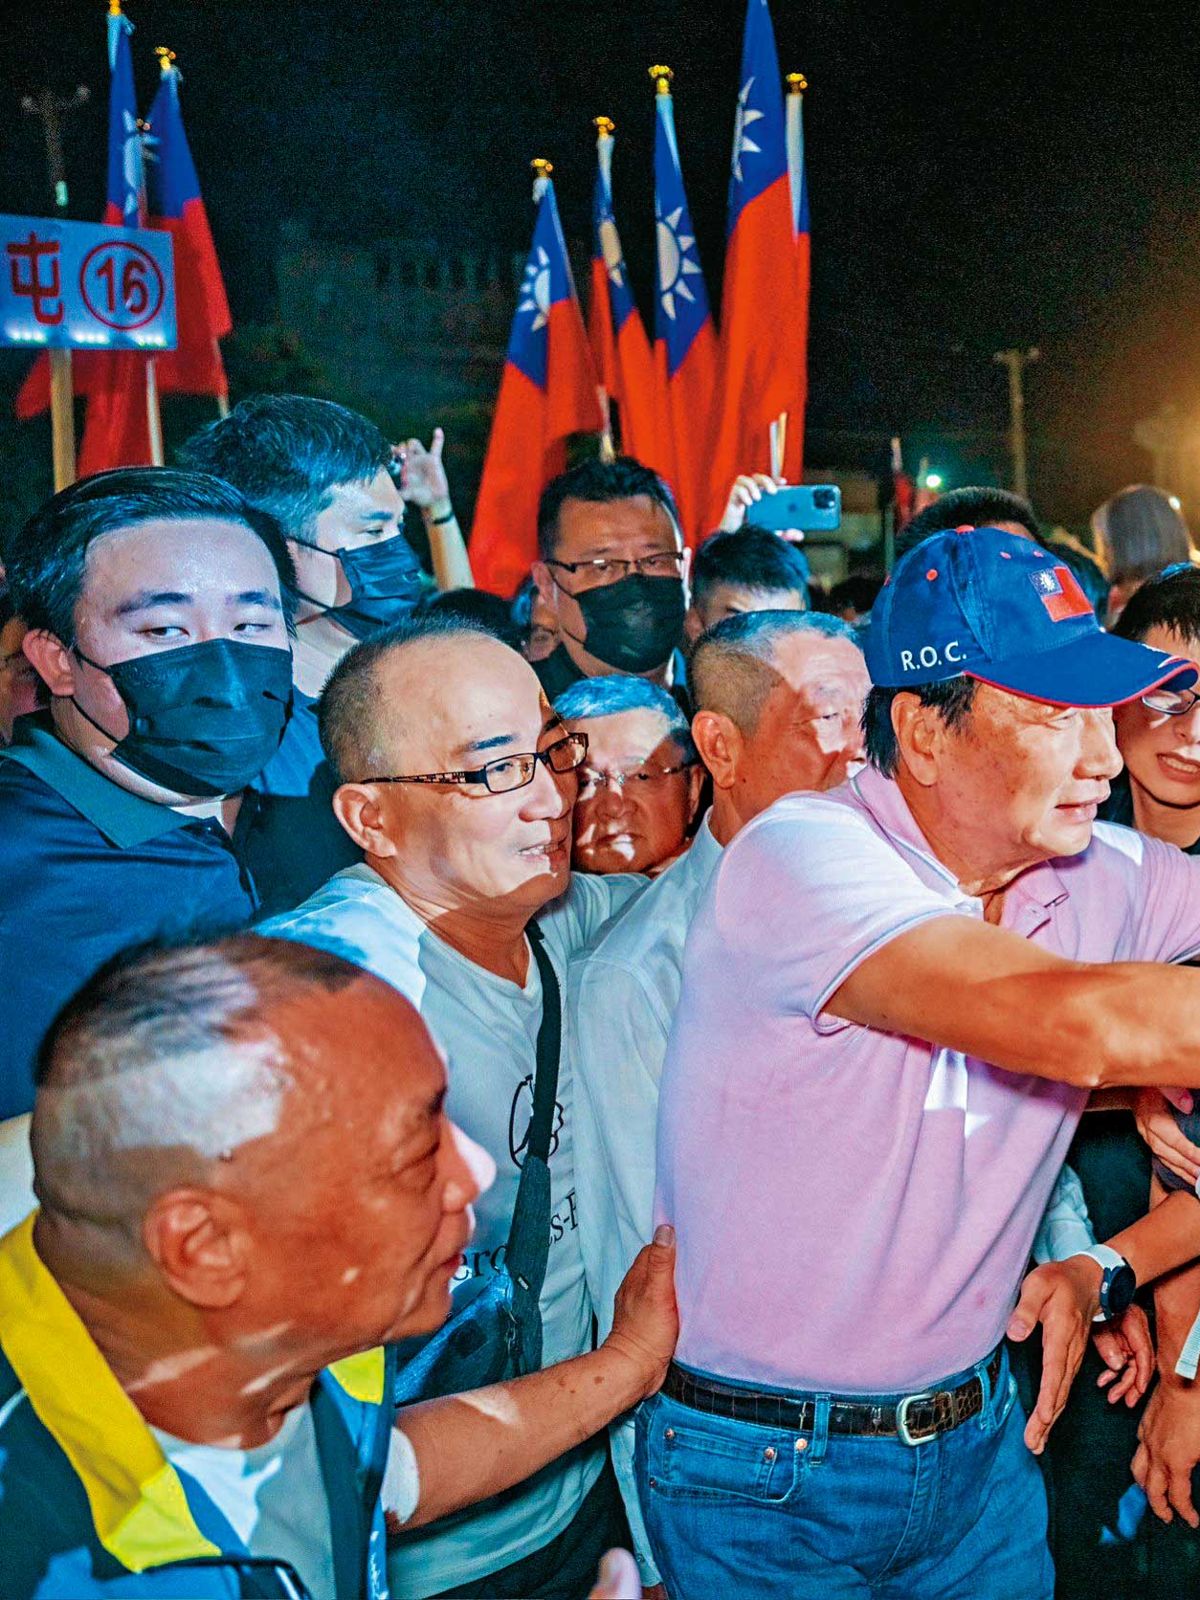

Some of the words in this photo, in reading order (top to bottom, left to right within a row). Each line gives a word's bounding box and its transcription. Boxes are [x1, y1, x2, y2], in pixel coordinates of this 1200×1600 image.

[7, 231, 63, 325] 屯
[97, 257, 149, 314] 16
[901, 640, 967, 671] R.O.C.
